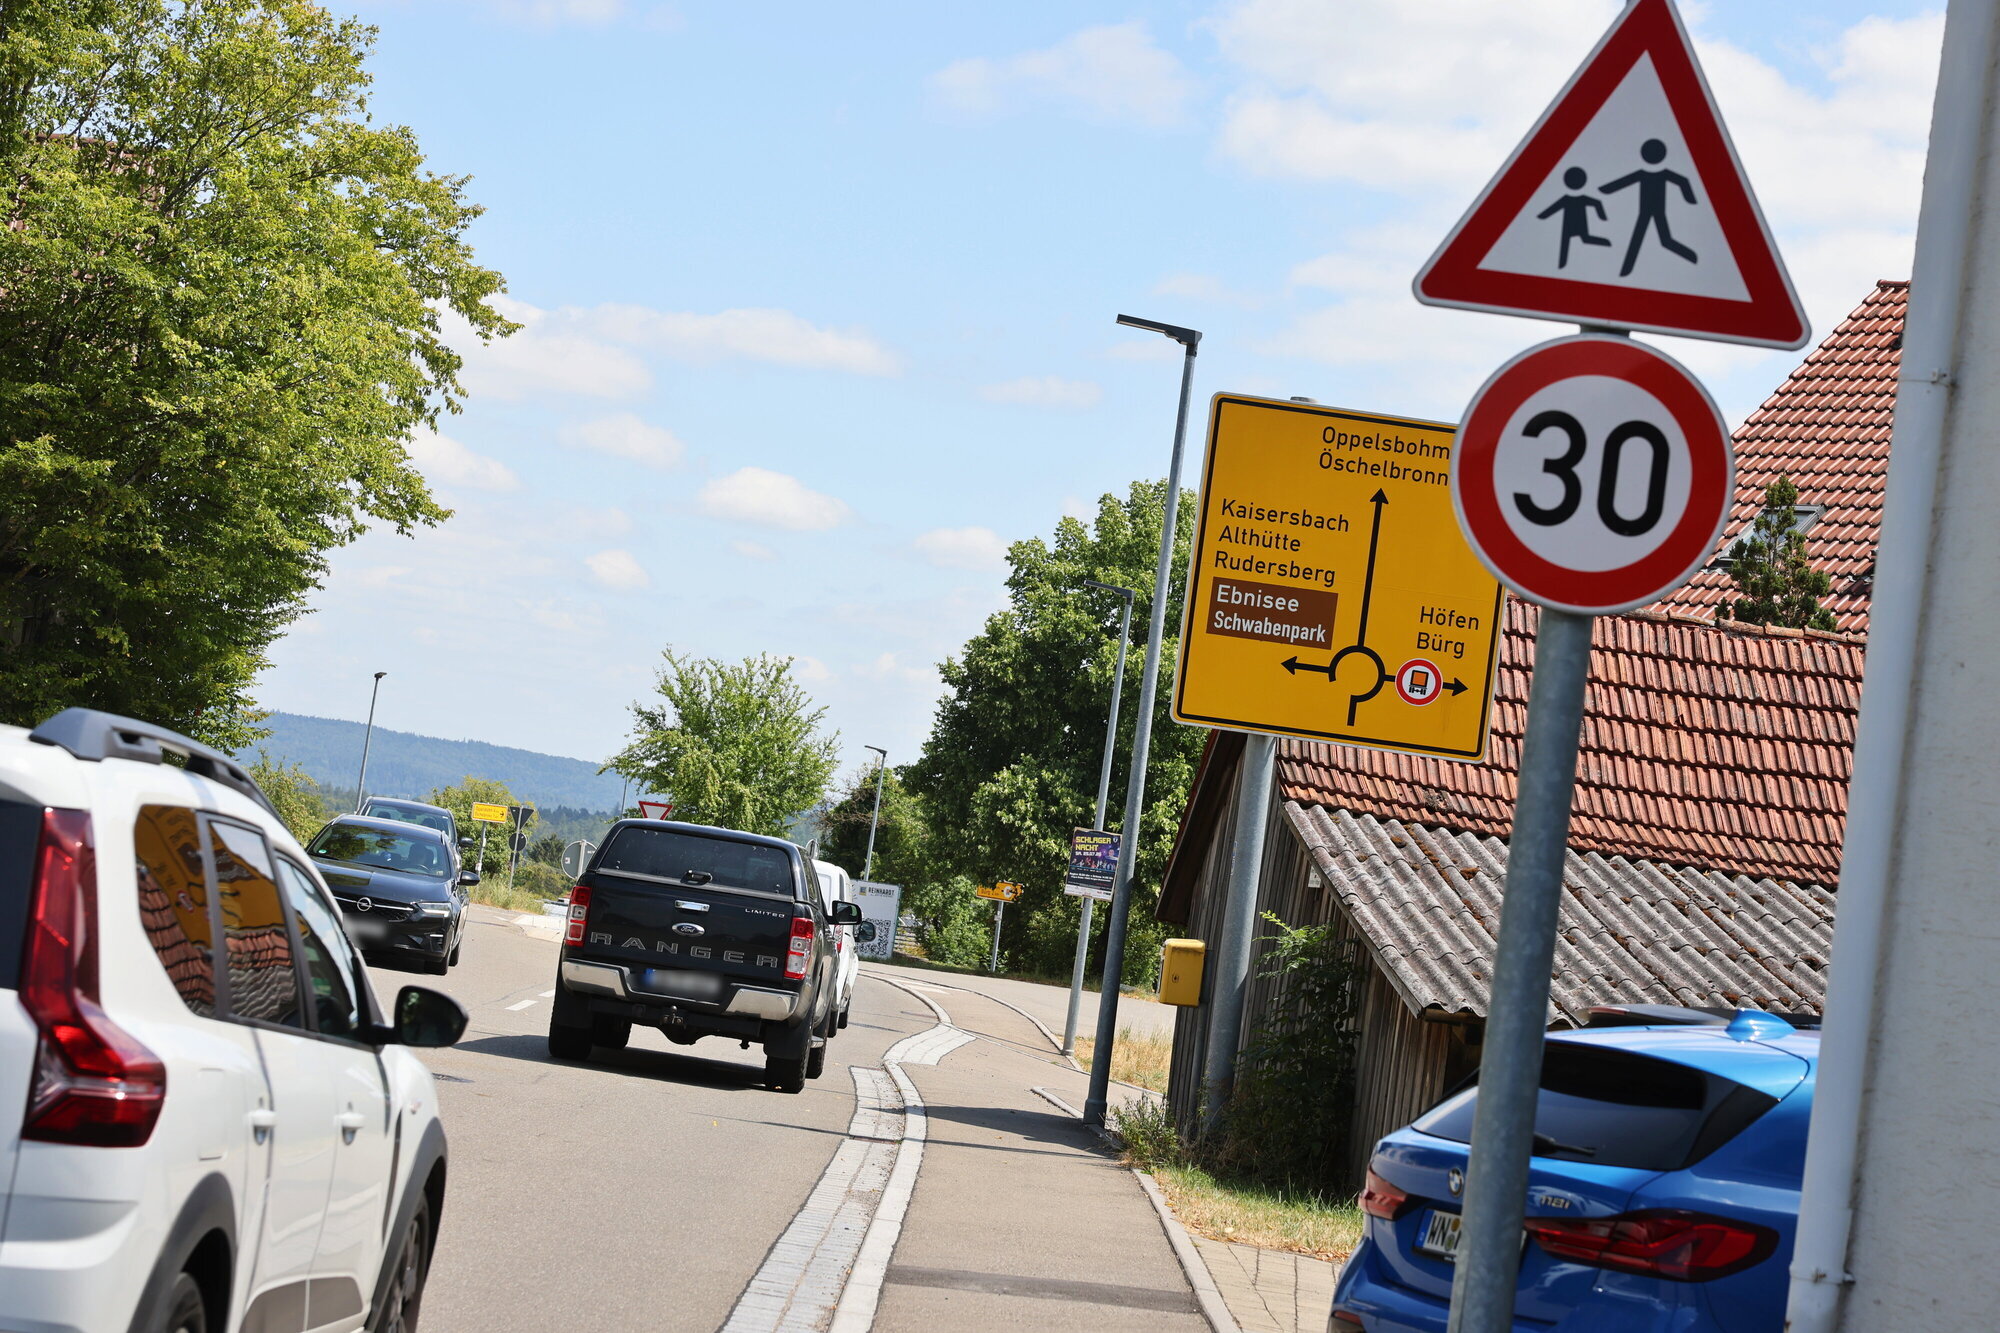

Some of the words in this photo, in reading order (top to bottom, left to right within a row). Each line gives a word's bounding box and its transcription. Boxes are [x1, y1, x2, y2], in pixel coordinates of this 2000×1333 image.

[1321, 426, 1450, 460] Oppelsbohm
[1318, 448, 1449, 486] Öschelbronn
[1513, 410, 1671, 537] 30
[1220, 498, 1350, 533] Kaisersbach
[1218, 525, 1301, 552] Althütte
[1214, 551, 1336, 588] Rudersberg
[1216, 584, 1300, 613] Ebnisee
[1213, 610, 1327, 643] Schwabenpark
[1419, 605, 1480, 631] Höfen
[1416, 631, 1466, 659] Bürg
[1076, 836, 1111, 844] SCHLAGER
[745, 908, 785, 919] LIMITED
[590, 931, 778, 968] RANGER
[1427, 1215, 1452, 1246] WN
